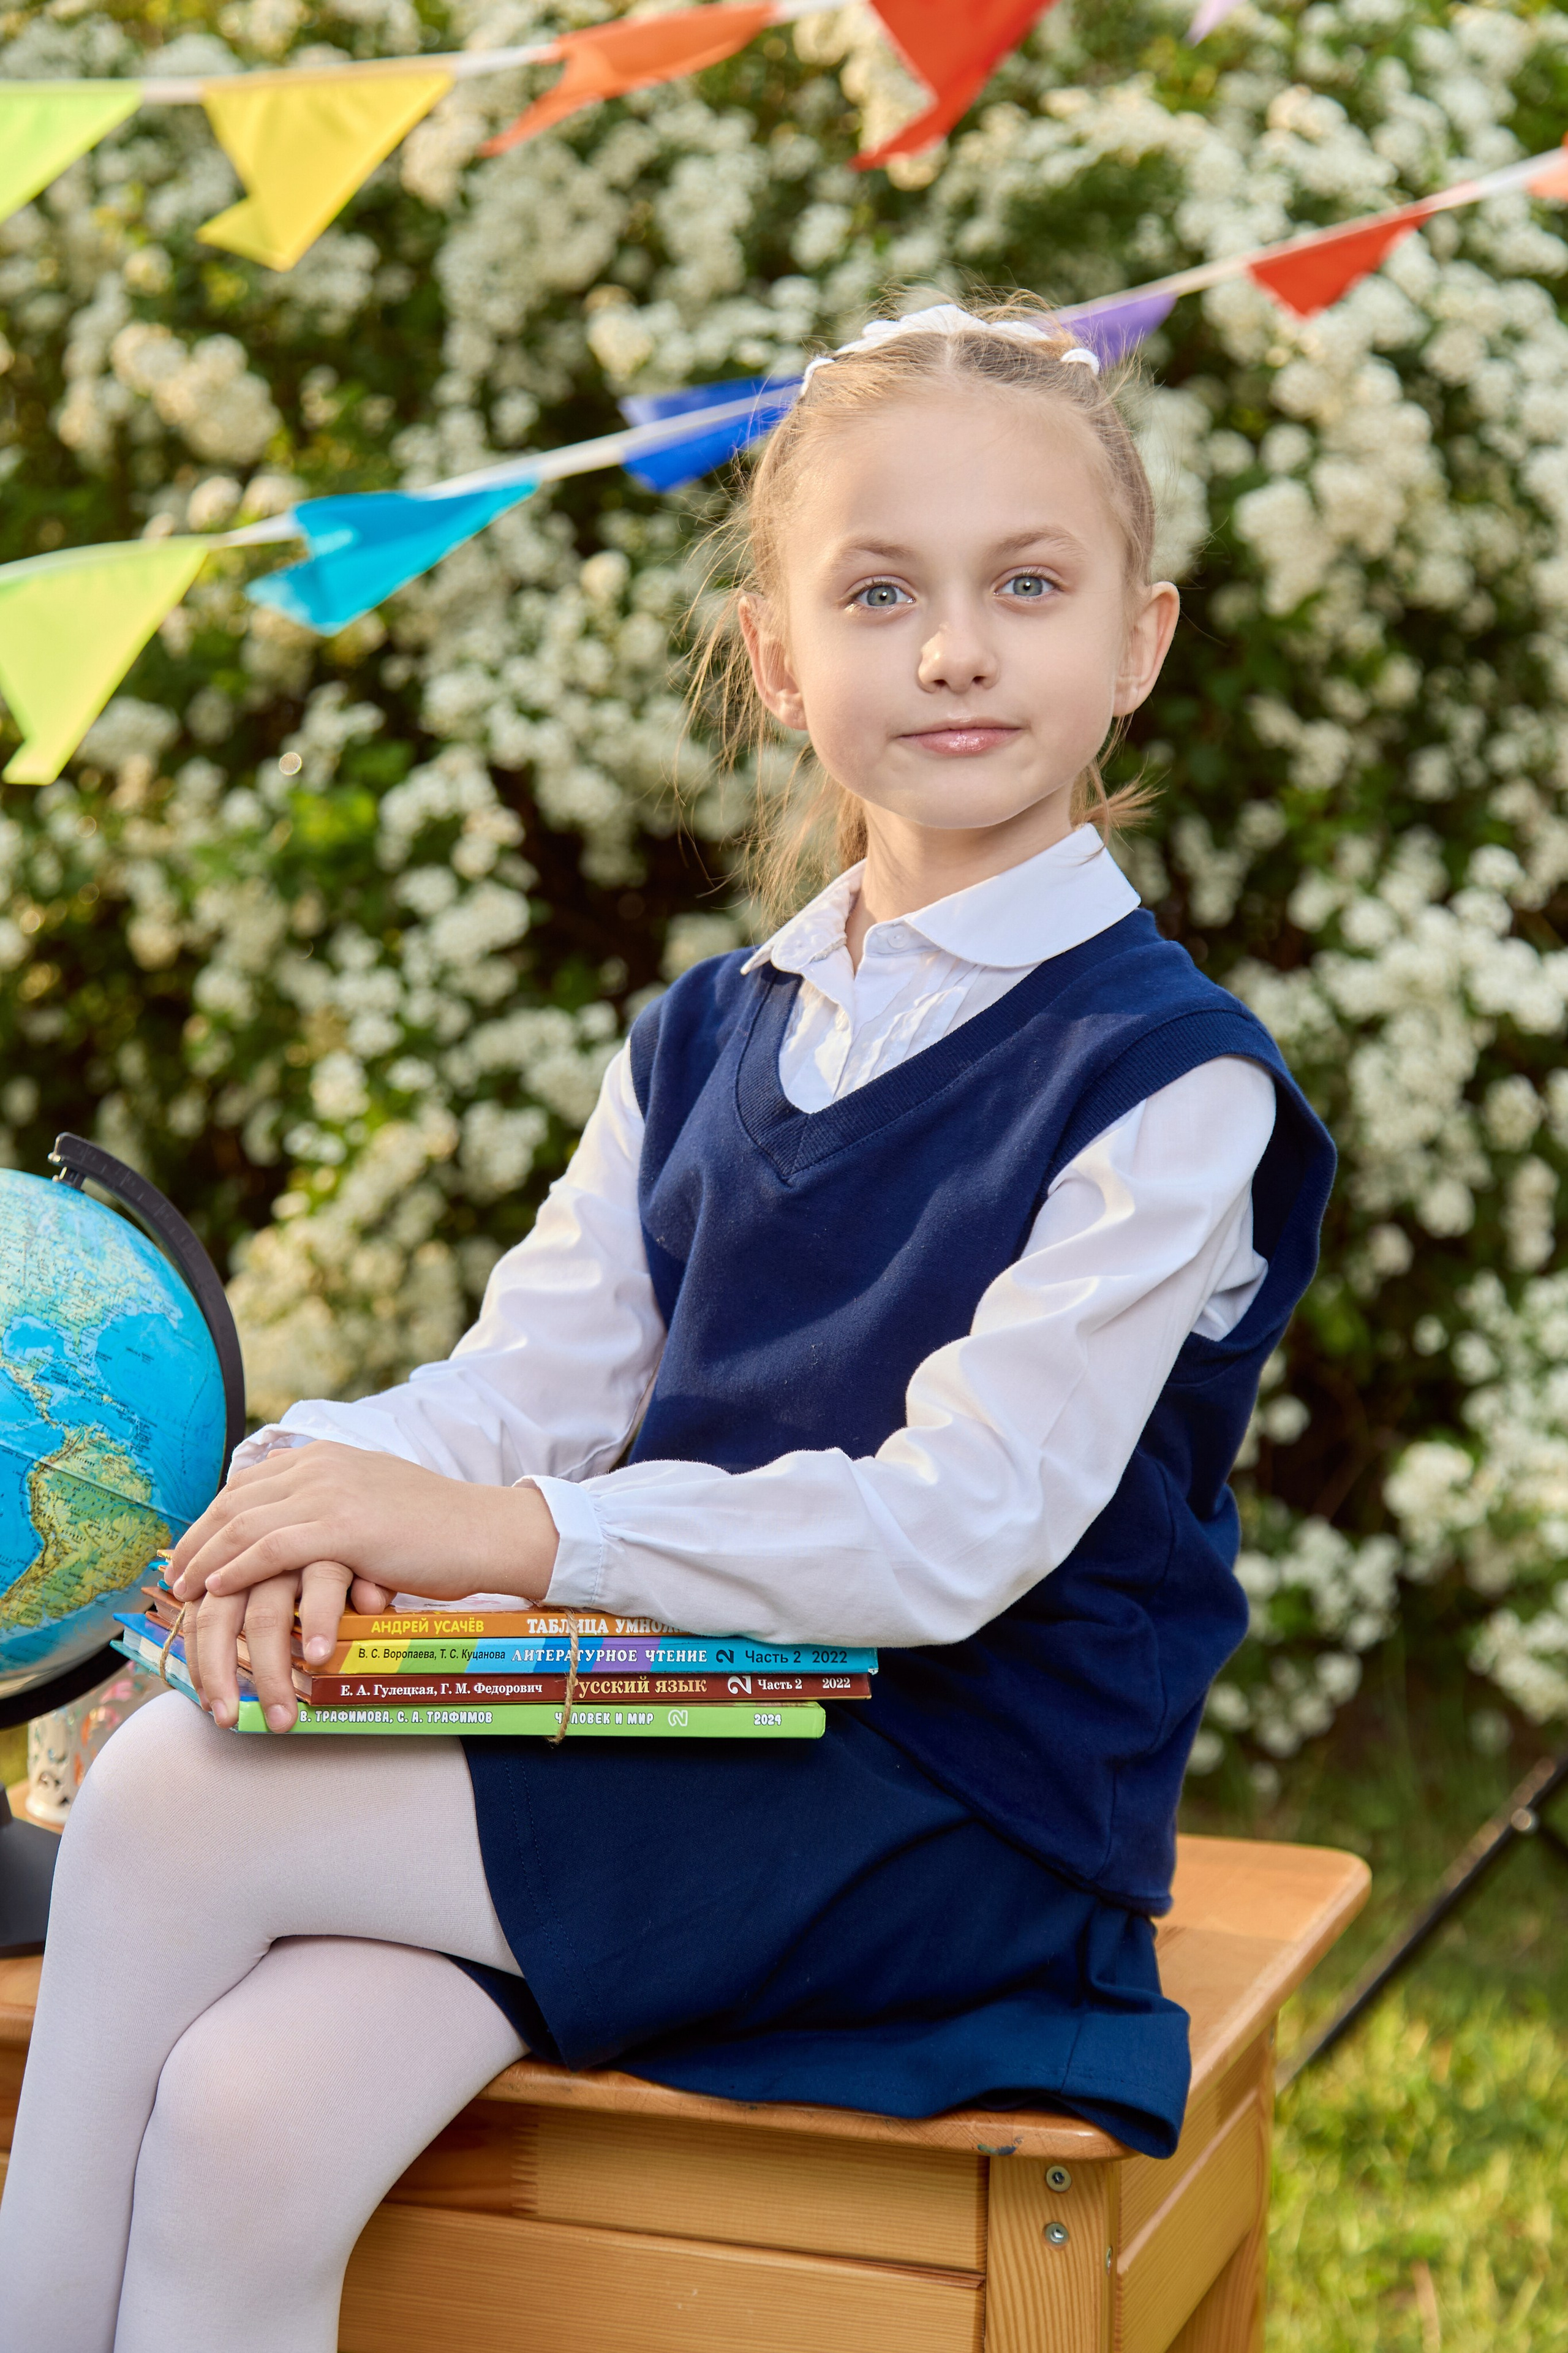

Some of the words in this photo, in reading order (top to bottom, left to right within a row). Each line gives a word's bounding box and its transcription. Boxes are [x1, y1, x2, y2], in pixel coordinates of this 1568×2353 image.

[371, 1617, 429, 1634] АНДРЕЙ
[434, 1617, 484, 1634] УСАЧЁВ
[358, 1649, 368, 1658] В.
[371, 1649, 380, 1658] С.
[383, 1649, 437, 1661] Воропаева,
[440, 1649, 447, 1658] Т.
[450, 1649, 459, 1658] С.
[462, 1649, 505, 1661] Куцанова
[645, 1649, 707, 1662] ЧТЕНИЕ
[716, 1649, 734, 1664] 2
[745, 1650, 788, 1663] Часть
[793, 1650, 801, 1663] 2
[812, 1650, 848, 1663] 2022
[341, 1685, 353, 1696] Е.
[356, 1685, 371, 1696] А.
[374, 1684, 437, 1698] Гулецкая,
[440, 1683, 452, 1694] Г.
[455, 1683, 470, 1694] М.
[473, 1683, 543, 1696] Федорович
[655, 1679, 707, 1693] язык
[728, 1675, 753, 1694] 2
[758, 1679, 793, 1691] Часть
[795, 1679, 802, 1690] 2
[822, 1677, 851, 1689] 2022
[300, 1710, 311, 1723] В.
[315, 1710, 393, 1723] ТРАФИМОВА,
[397, 1710, 409, 1723] С.
[412, 1710, 423, 1723] А.
[427, 1711, 493, 1723] ТРАФИМОВ
[554, 1712, 611, 1724] ЧЛОВЕК
[615, 1712, 623, 1724] И
[627, 1712, 654, 1724] МИР
[668, 1709, 688, 1726] 2
[754, 1713, 782, 1726] 2024
